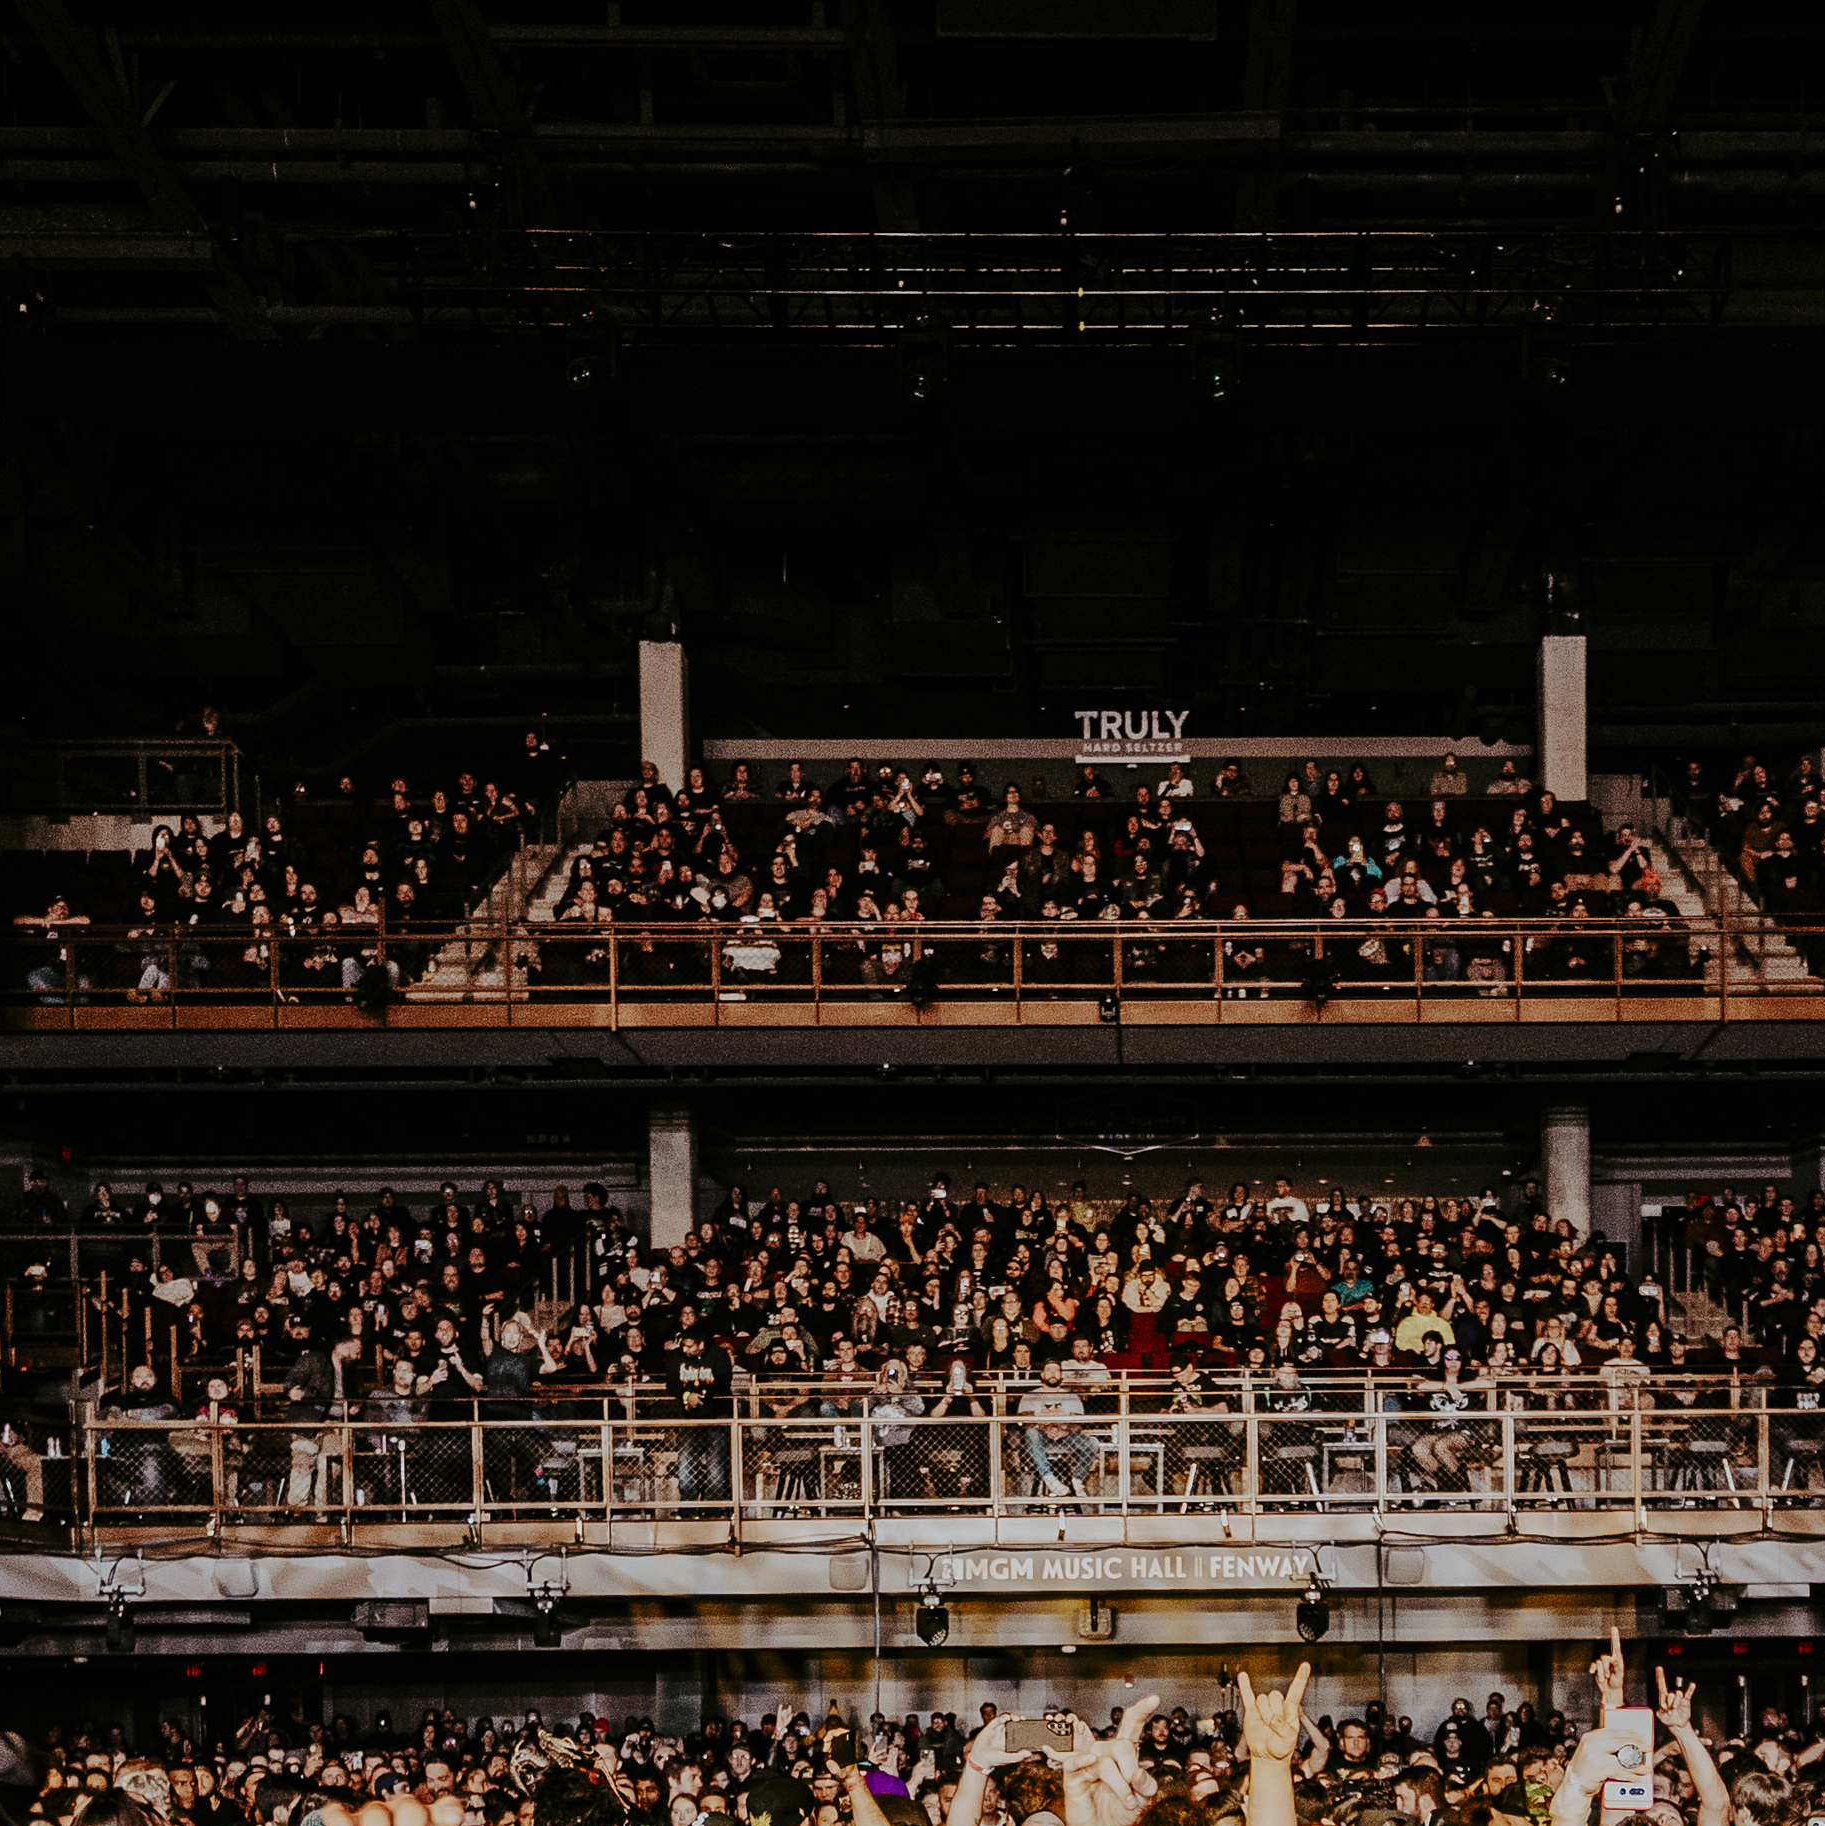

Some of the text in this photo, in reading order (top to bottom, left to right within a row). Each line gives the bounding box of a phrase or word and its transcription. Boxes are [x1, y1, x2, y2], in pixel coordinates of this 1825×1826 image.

[1074, 709, 1190, 740] TRULY
[1083, 742, 1183, 753] HARD SELTZER
[965, 1555, 1309, 1580] MGM MUSIC HALL FENWAY
